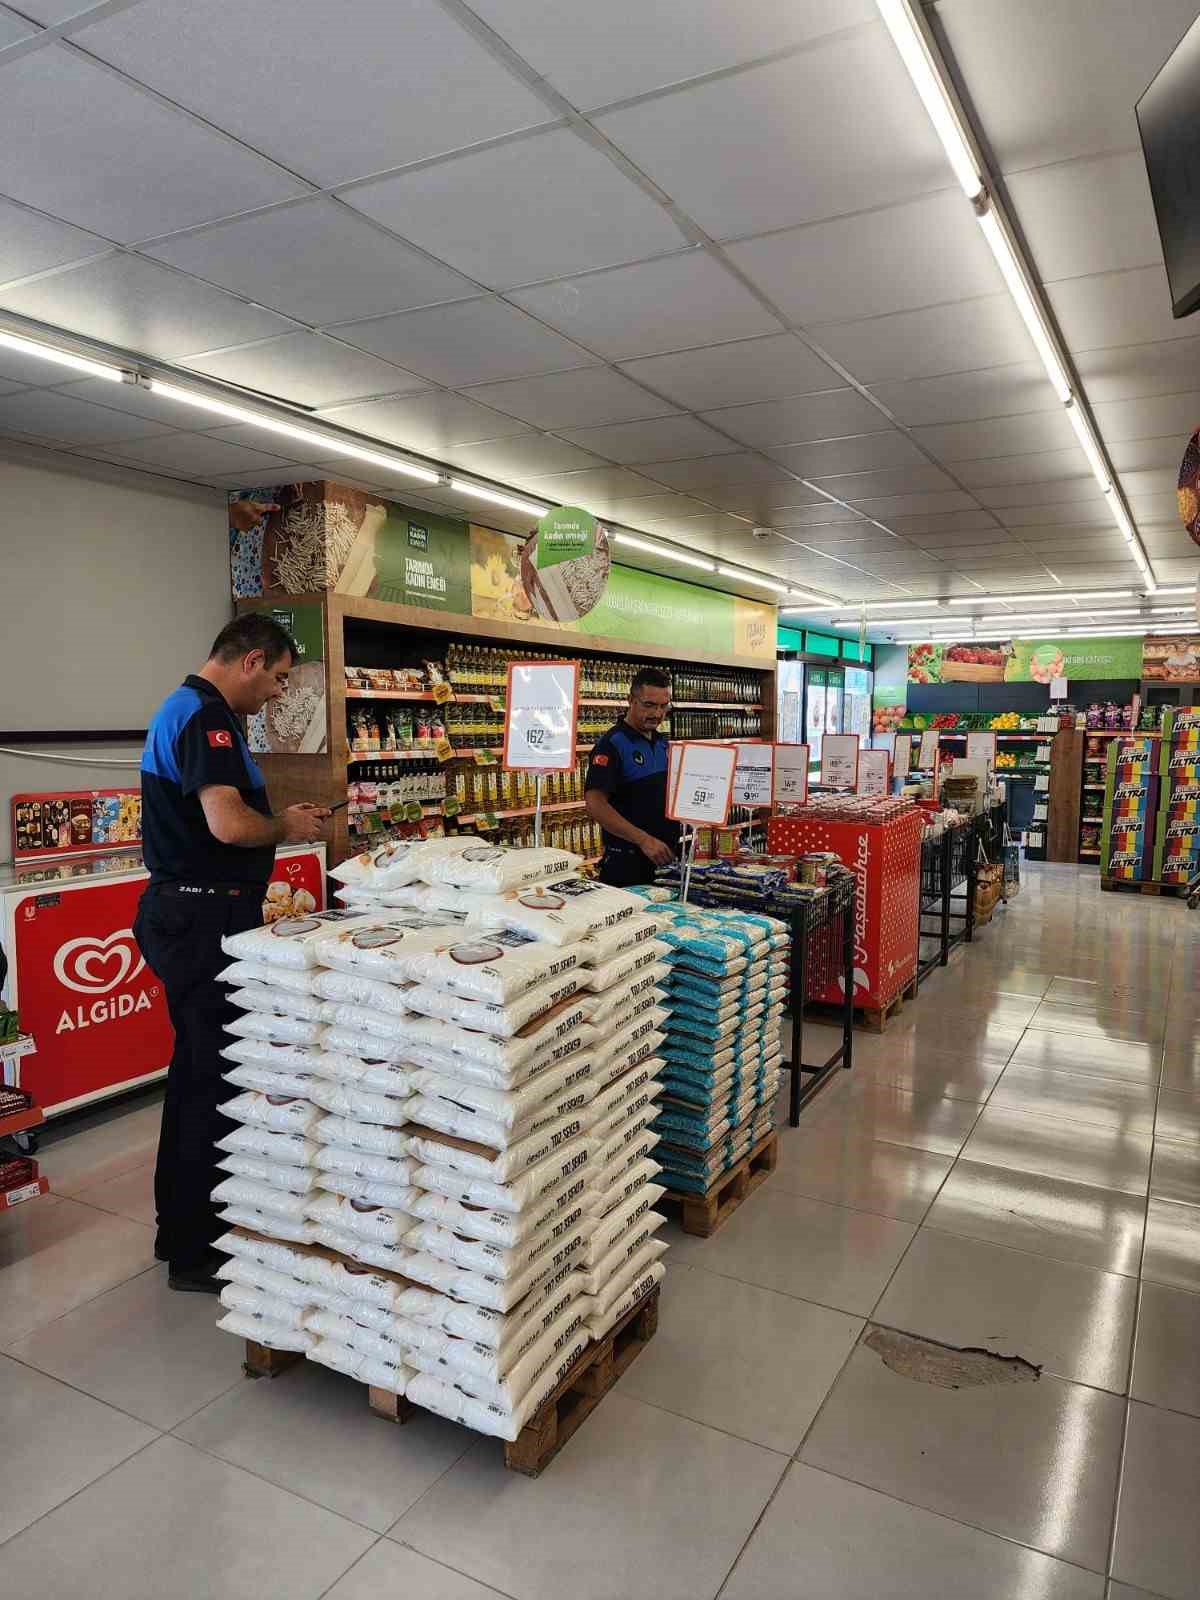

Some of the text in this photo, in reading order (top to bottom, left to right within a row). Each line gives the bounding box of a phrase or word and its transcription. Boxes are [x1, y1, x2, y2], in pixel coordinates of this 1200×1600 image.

[526, 729, 544, 744] 162
[1118, 753, 1148, 764] ULTRA
[1116, 789, 1146, 799] ULTRA
